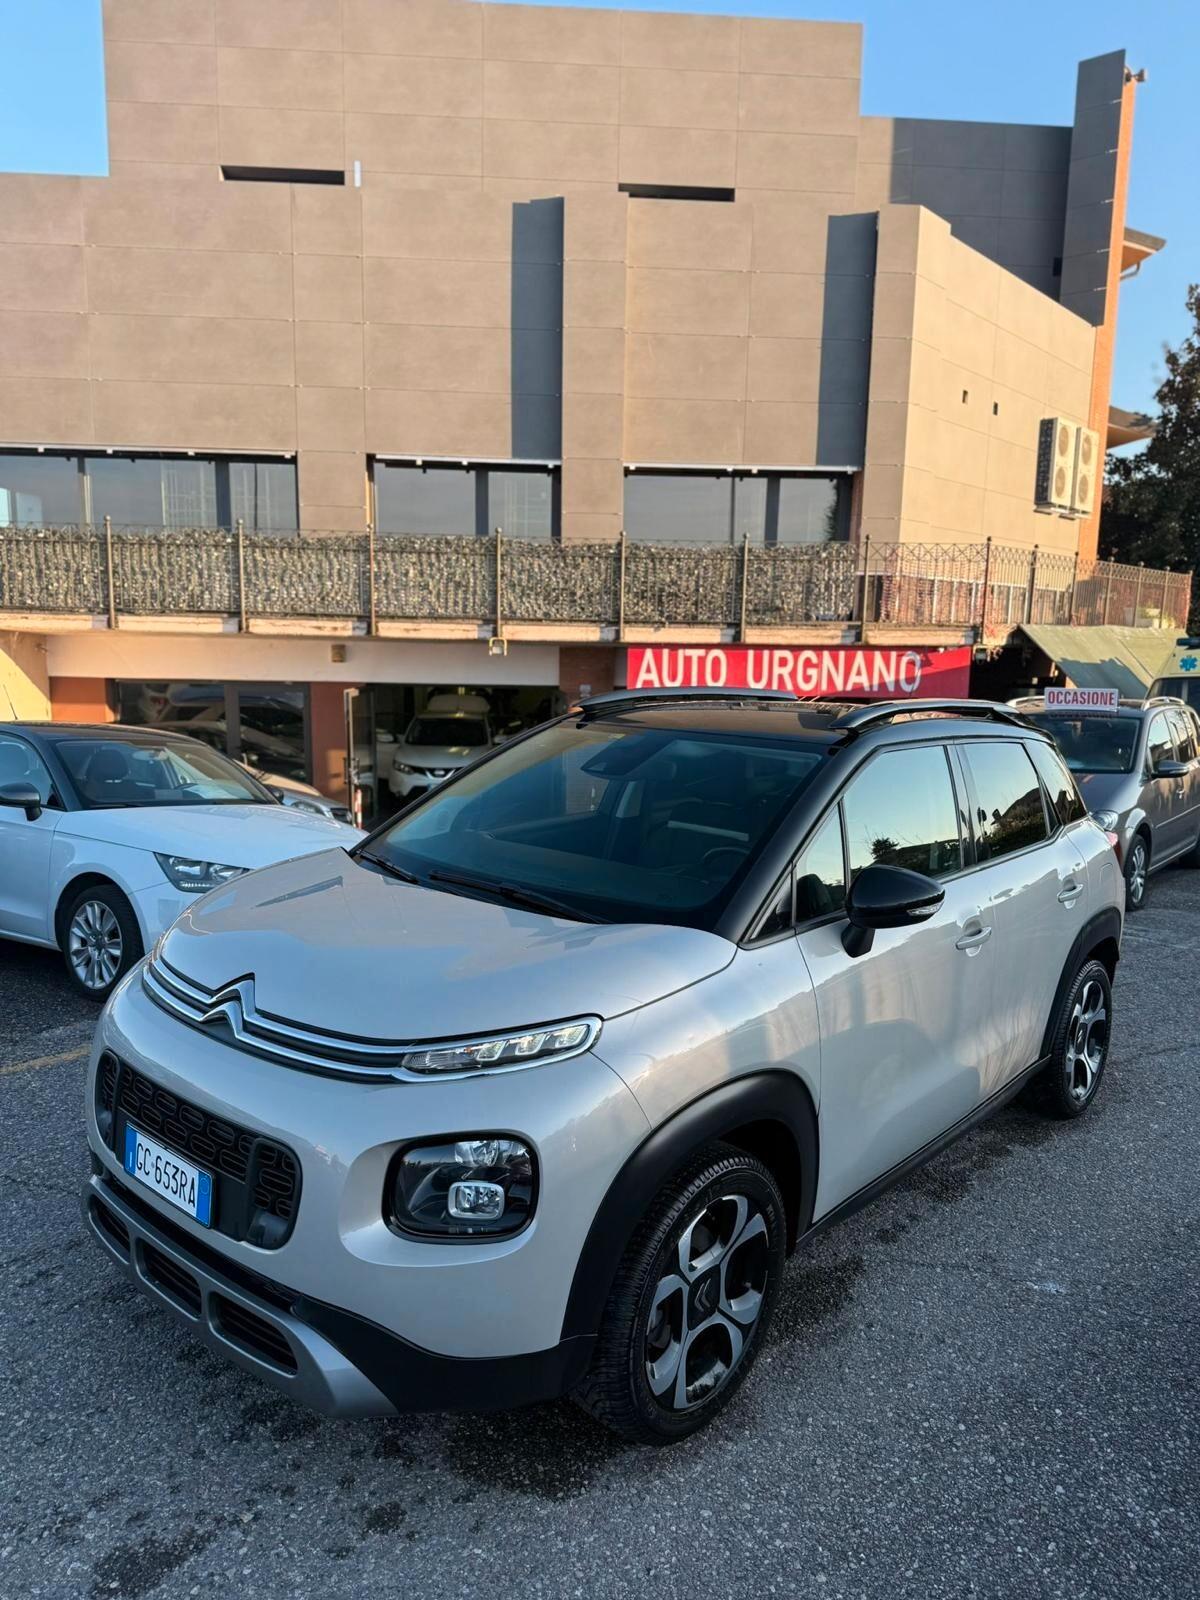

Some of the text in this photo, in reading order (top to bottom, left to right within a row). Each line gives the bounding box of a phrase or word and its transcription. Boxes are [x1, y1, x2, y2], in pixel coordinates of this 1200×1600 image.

[635, 648, 922, 693] AUTO URGNANO
[1047, 691, 1116, 706] OCCASIONE
